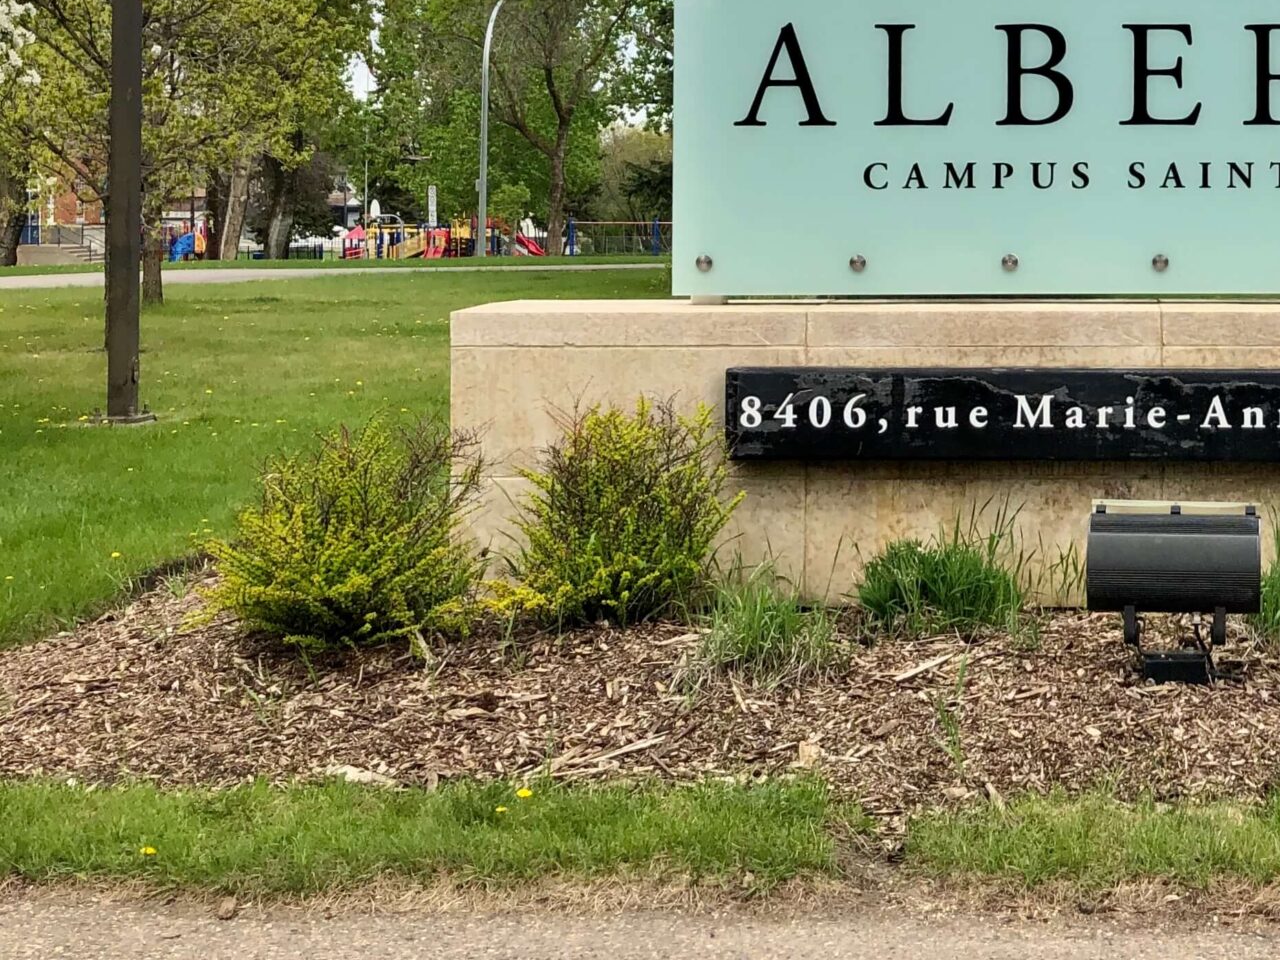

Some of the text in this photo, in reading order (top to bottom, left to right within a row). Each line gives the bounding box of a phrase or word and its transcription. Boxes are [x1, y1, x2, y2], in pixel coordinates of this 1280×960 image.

[863, 161, 1090, 190] CAMPUS
[740, 393, 889, 433] 8406,
[906, 406, 988, 428] rue
